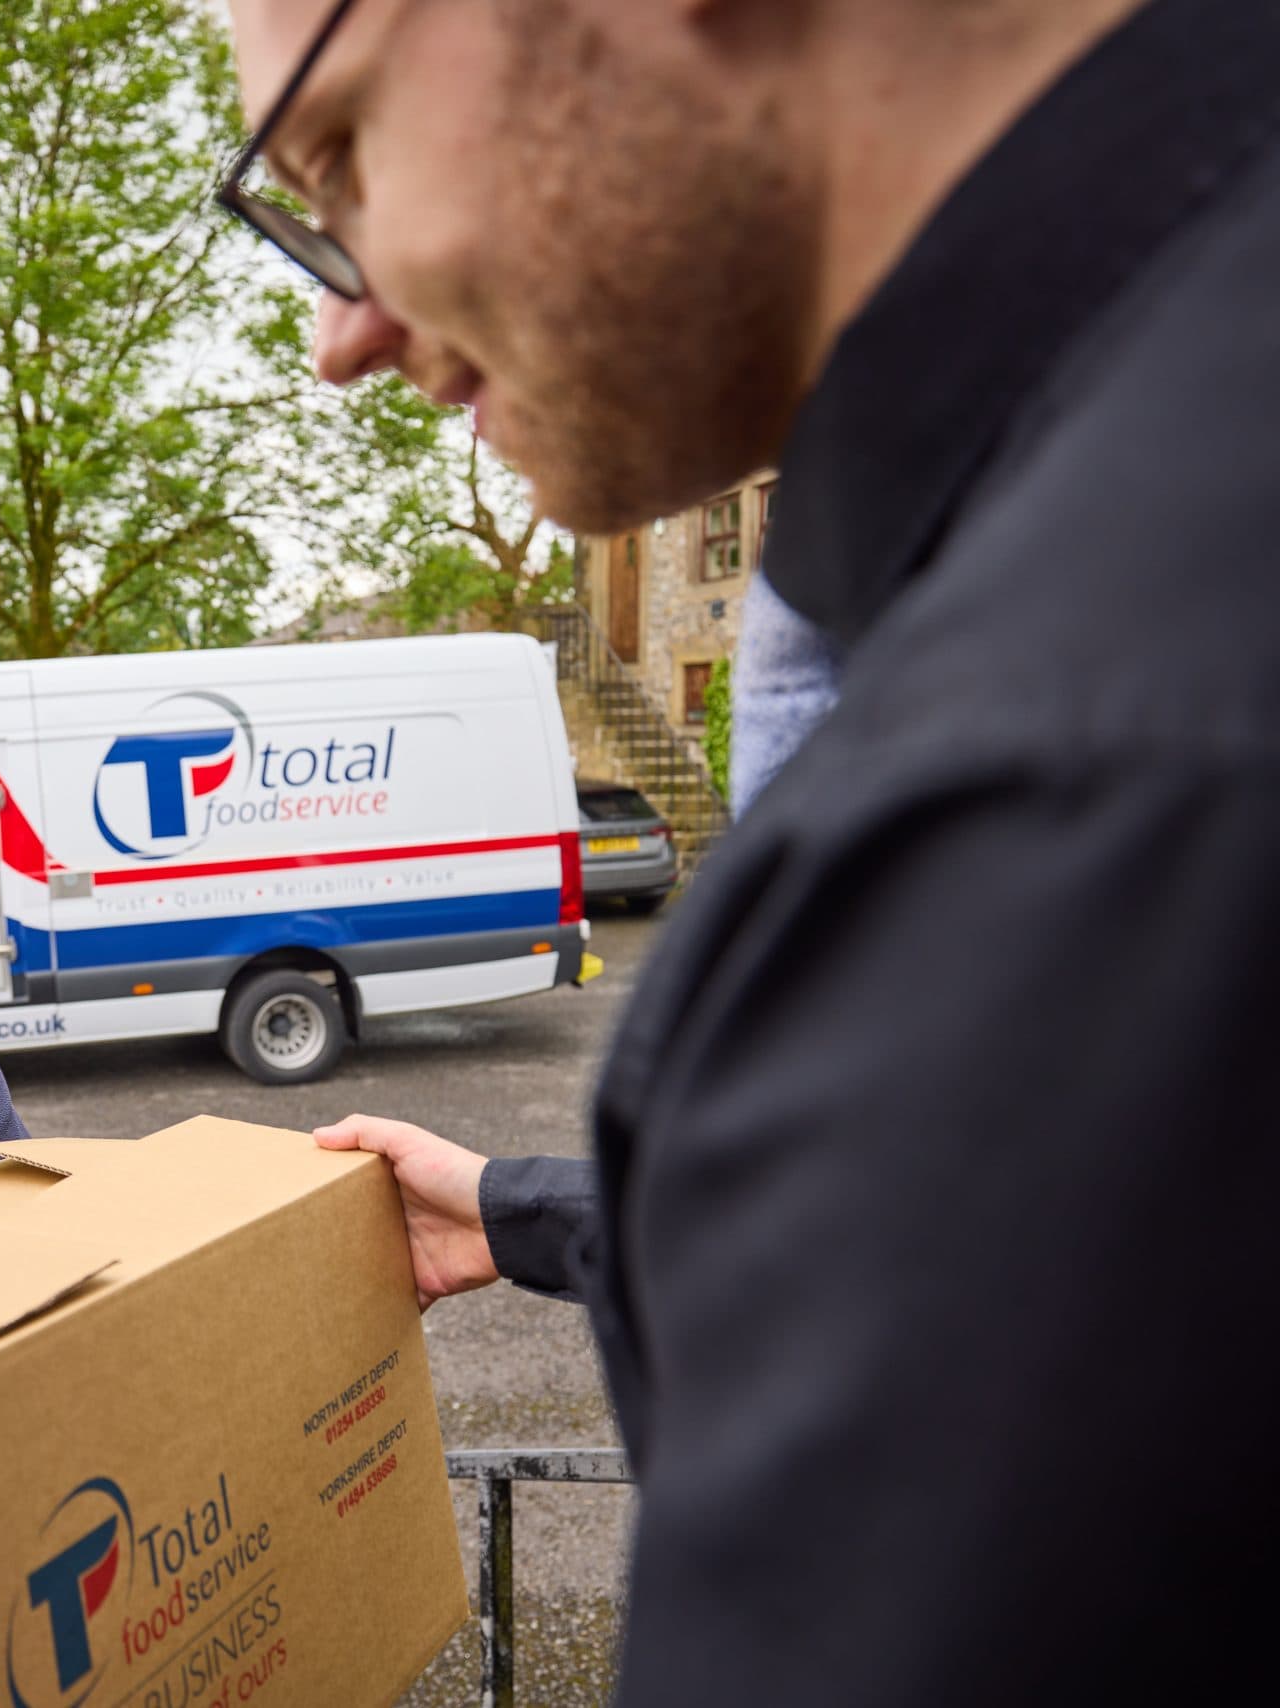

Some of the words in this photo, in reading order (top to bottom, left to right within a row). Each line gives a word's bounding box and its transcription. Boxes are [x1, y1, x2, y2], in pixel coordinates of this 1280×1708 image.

[259, 726, 396, 788] total
[201, 789, 389, 837] foodservice
[96, 897, 146, 913] Trust
[174, 888, 246, 907] Quality
[274, 875, 376, 896] Reliability
[402, 869, 456, 886] Value
[303, 1398, 339, 1438] NORTH
[340, 1376, 368, 1407] WEST
[369, 1350, 400, 1385] DEPOT
[319, 1448, 376, 1506] YORKSHIRE
[378, 1419, 407, 1457] DEPOT
[138, 1471, 232, 1588] Total
[122, 1522, 272, 1665] foodservice
[237, 1637, 288, 1701] ours
